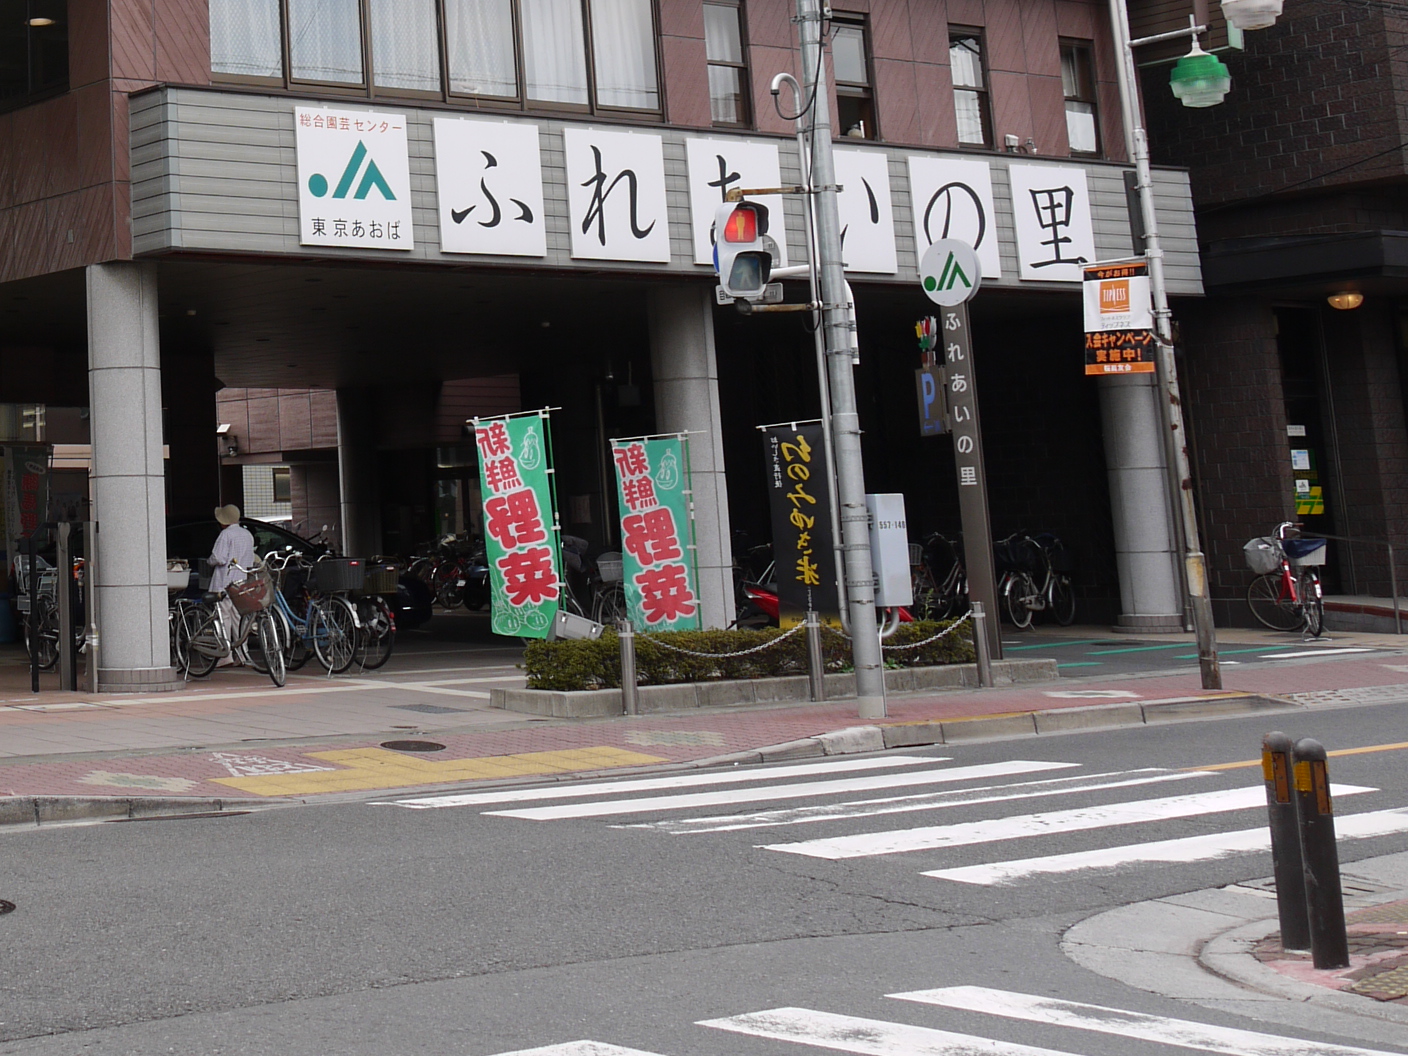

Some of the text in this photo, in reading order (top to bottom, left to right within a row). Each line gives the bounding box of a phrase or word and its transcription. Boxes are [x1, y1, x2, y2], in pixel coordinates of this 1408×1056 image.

[299, 113, 403, 134] 総合園芸センター
[310, 217, 402, 240] 東京あおば
[1085, 331, 1152, 349] 入会キャンペーン
[1096, 348, 1142, 362] 実施中!
[921, 373, 936, 420] P
[945, 313, 978, 486] ふれあいの里
